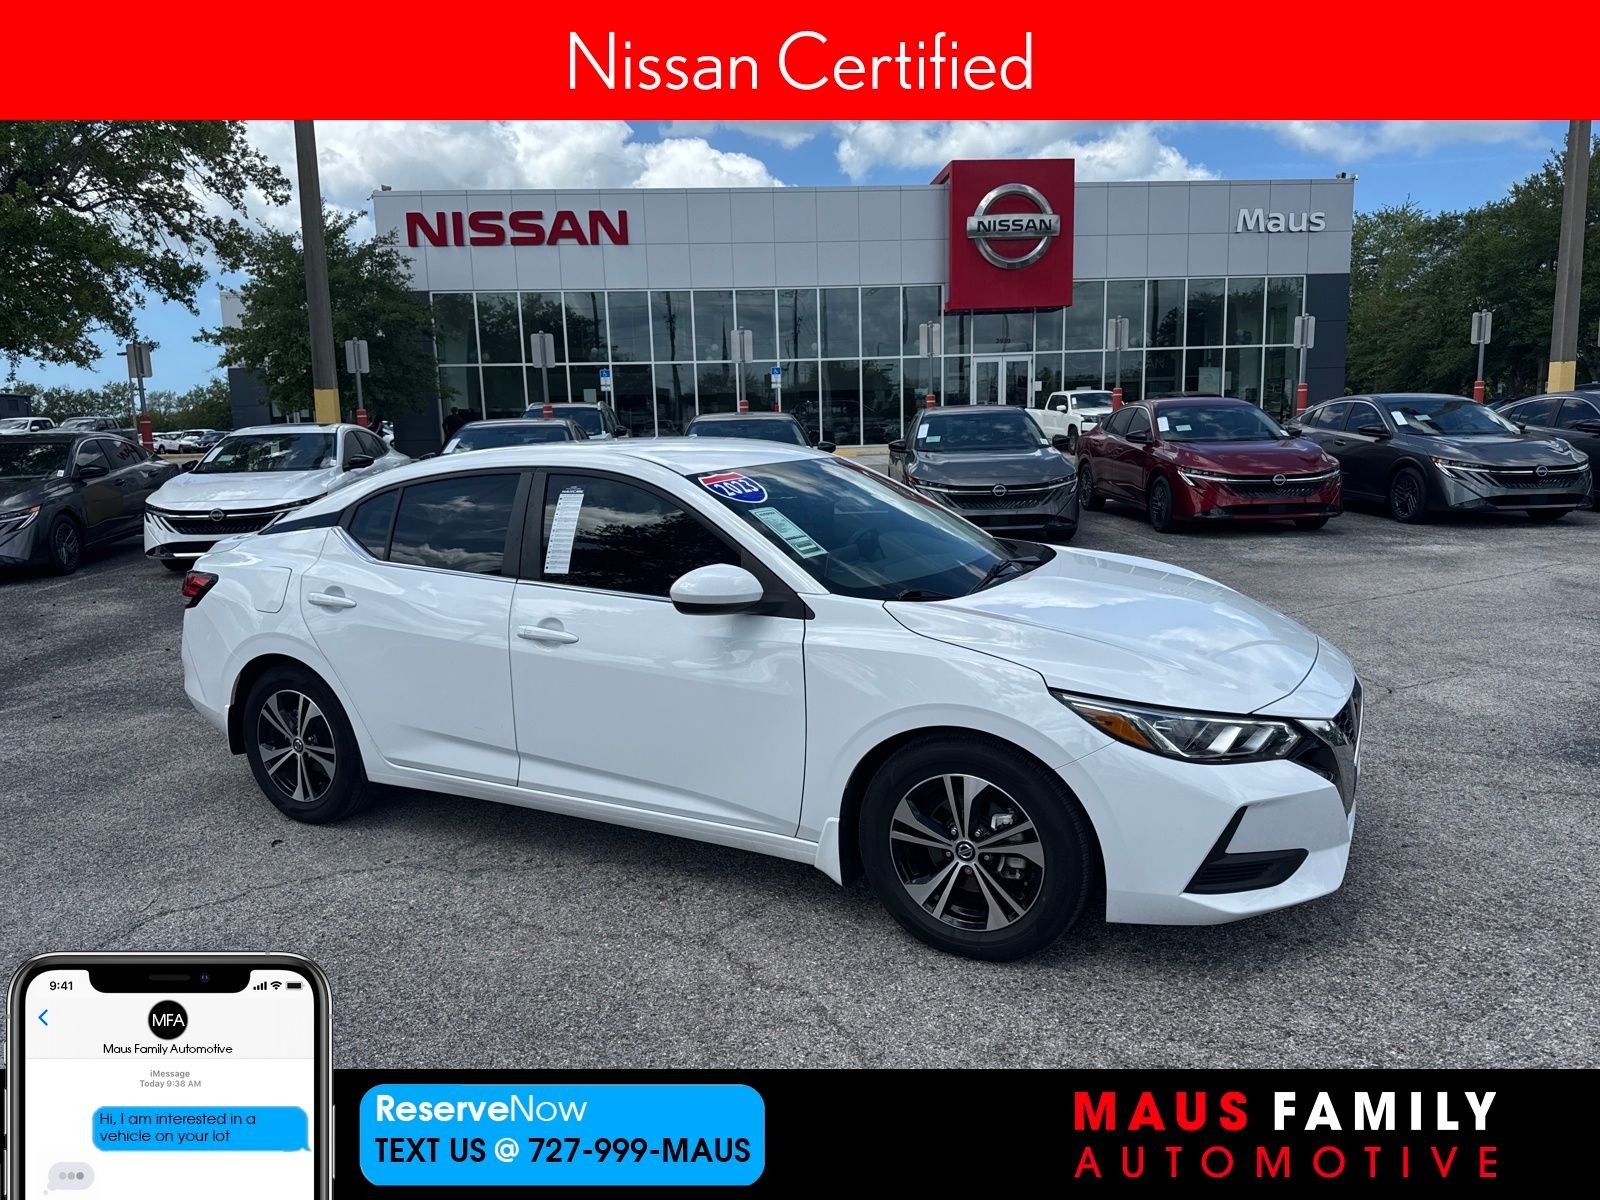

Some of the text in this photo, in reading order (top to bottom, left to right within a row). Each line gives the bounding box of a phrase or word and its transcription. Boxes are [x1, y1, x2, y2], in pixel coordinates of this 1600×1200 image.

[406, 209, 628, 247] NISSAN
[976, 219, 1052, 232] NISSAN
[1235, 207, 1327, 233] Maus
[713, 479, 759, 496] 2023
